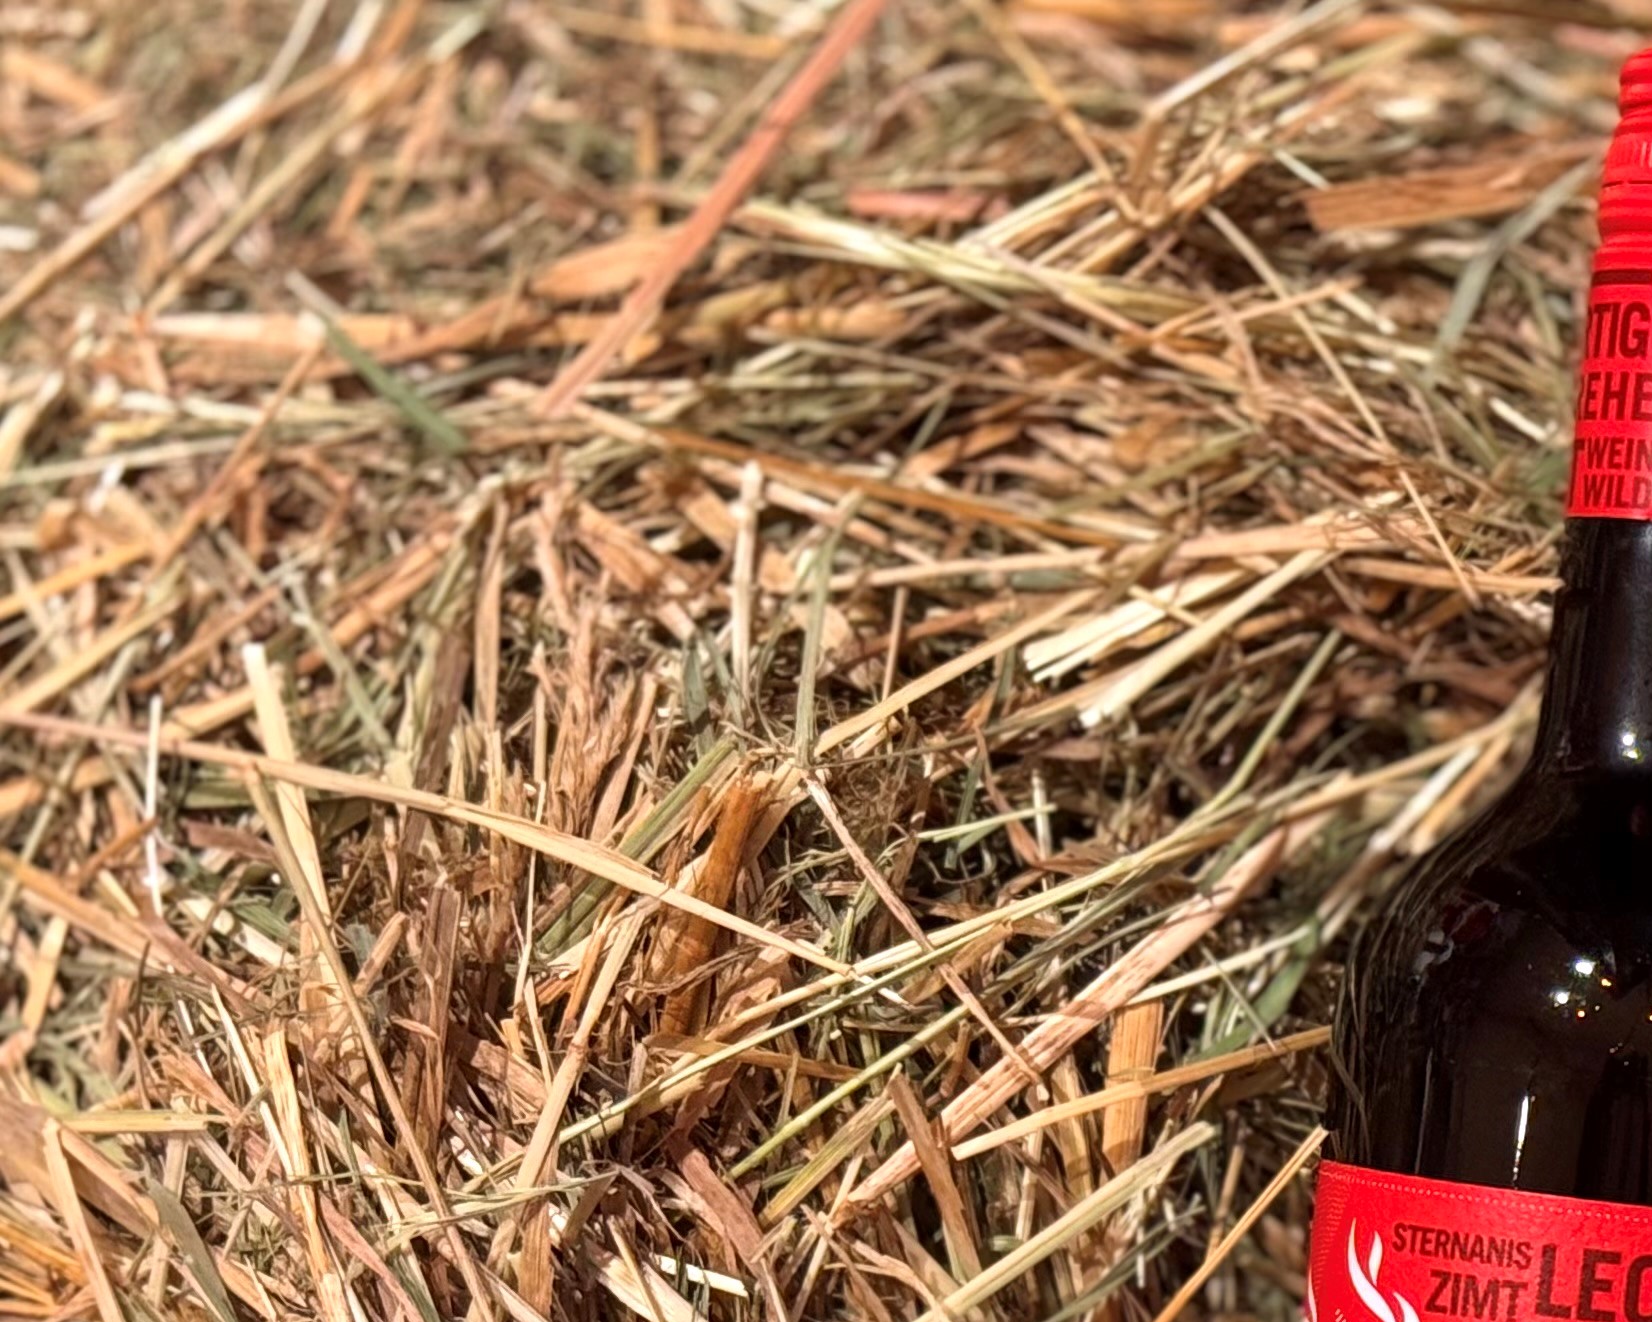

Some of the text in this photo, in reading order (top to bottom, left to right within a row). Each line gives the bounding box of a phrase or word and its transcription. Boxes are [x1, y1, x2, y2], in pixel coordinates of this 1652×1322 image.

[1583, 474, 1652, 511] WILD
[1392, 1222, 1533, 1270] STERNANIS
[1424, 1269, 1529, 1322] ZIMT
